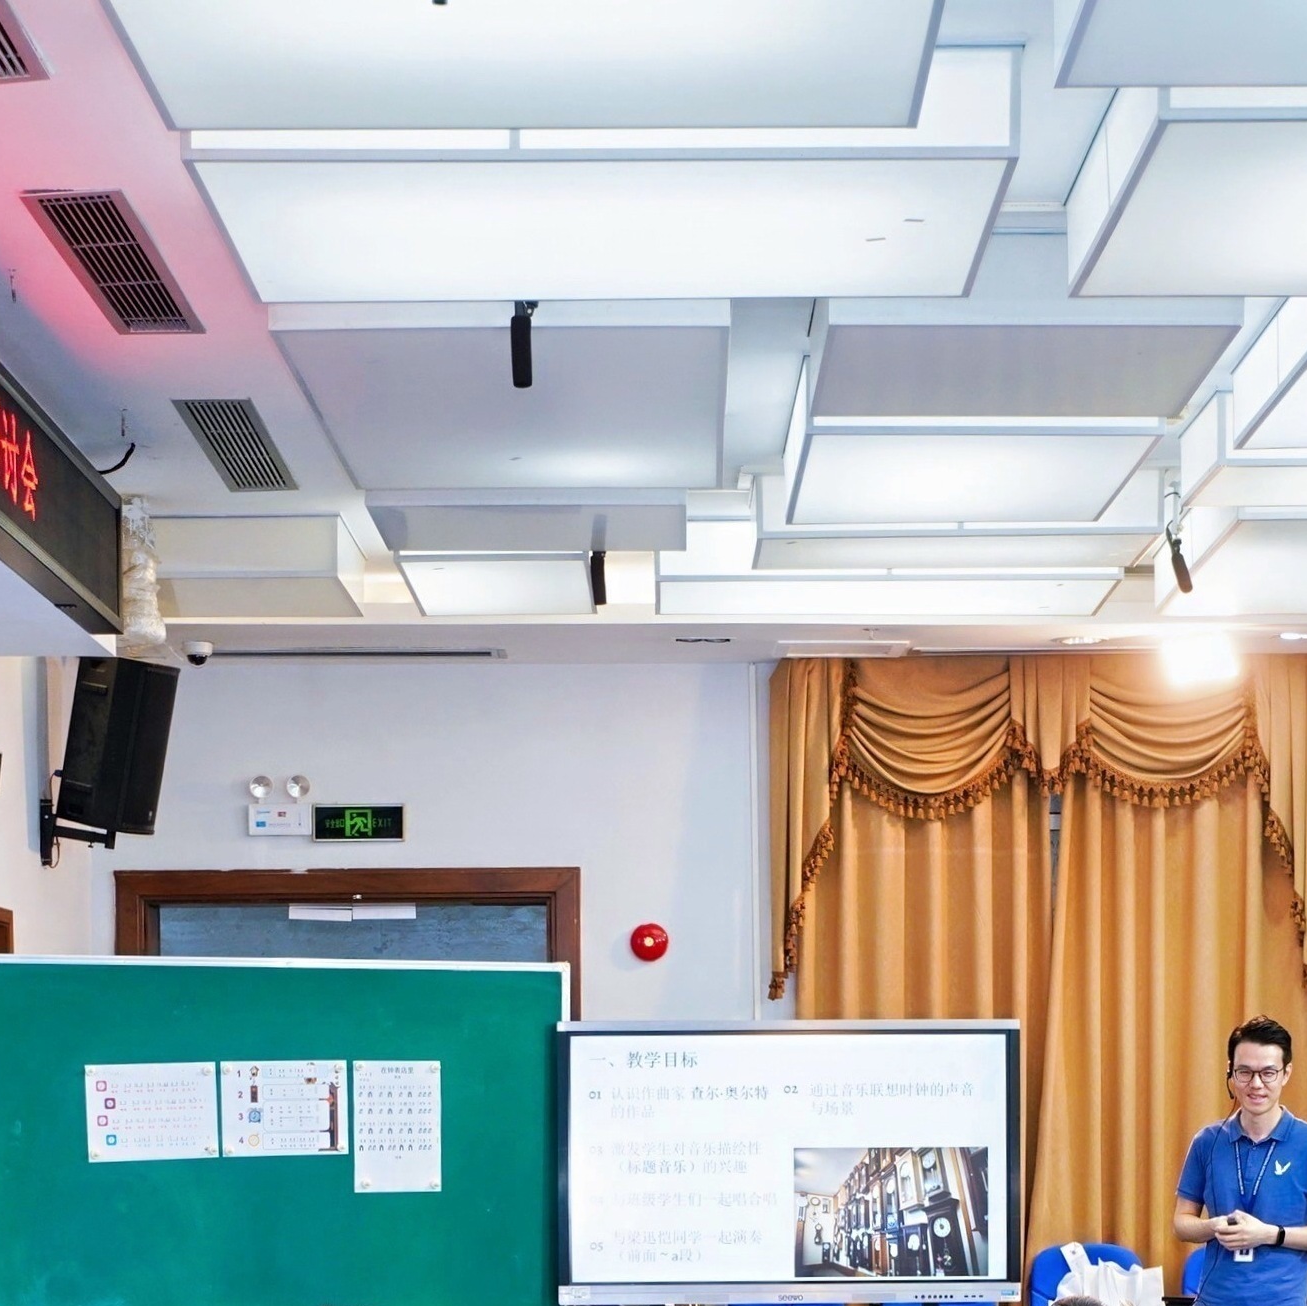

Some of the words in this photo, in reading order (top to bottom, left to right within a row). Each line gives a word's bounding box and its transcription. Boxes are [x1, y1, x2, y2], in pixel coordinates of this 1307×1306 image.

[373, 818, 392, 828] EXIT
[589, 1051, 698, 1069] 一、教学目标
[589, 1091, 602, 1100] 01
[783, 1084, 798, 1094] 02
[810, 1082, 974, 1098] 通过音乐联想时钟的声音
[611, 1105, 655, 1119] 的作品
[813, 1101, 854, 1116] 与场景
[589, 1241, 604, 1252] 05
